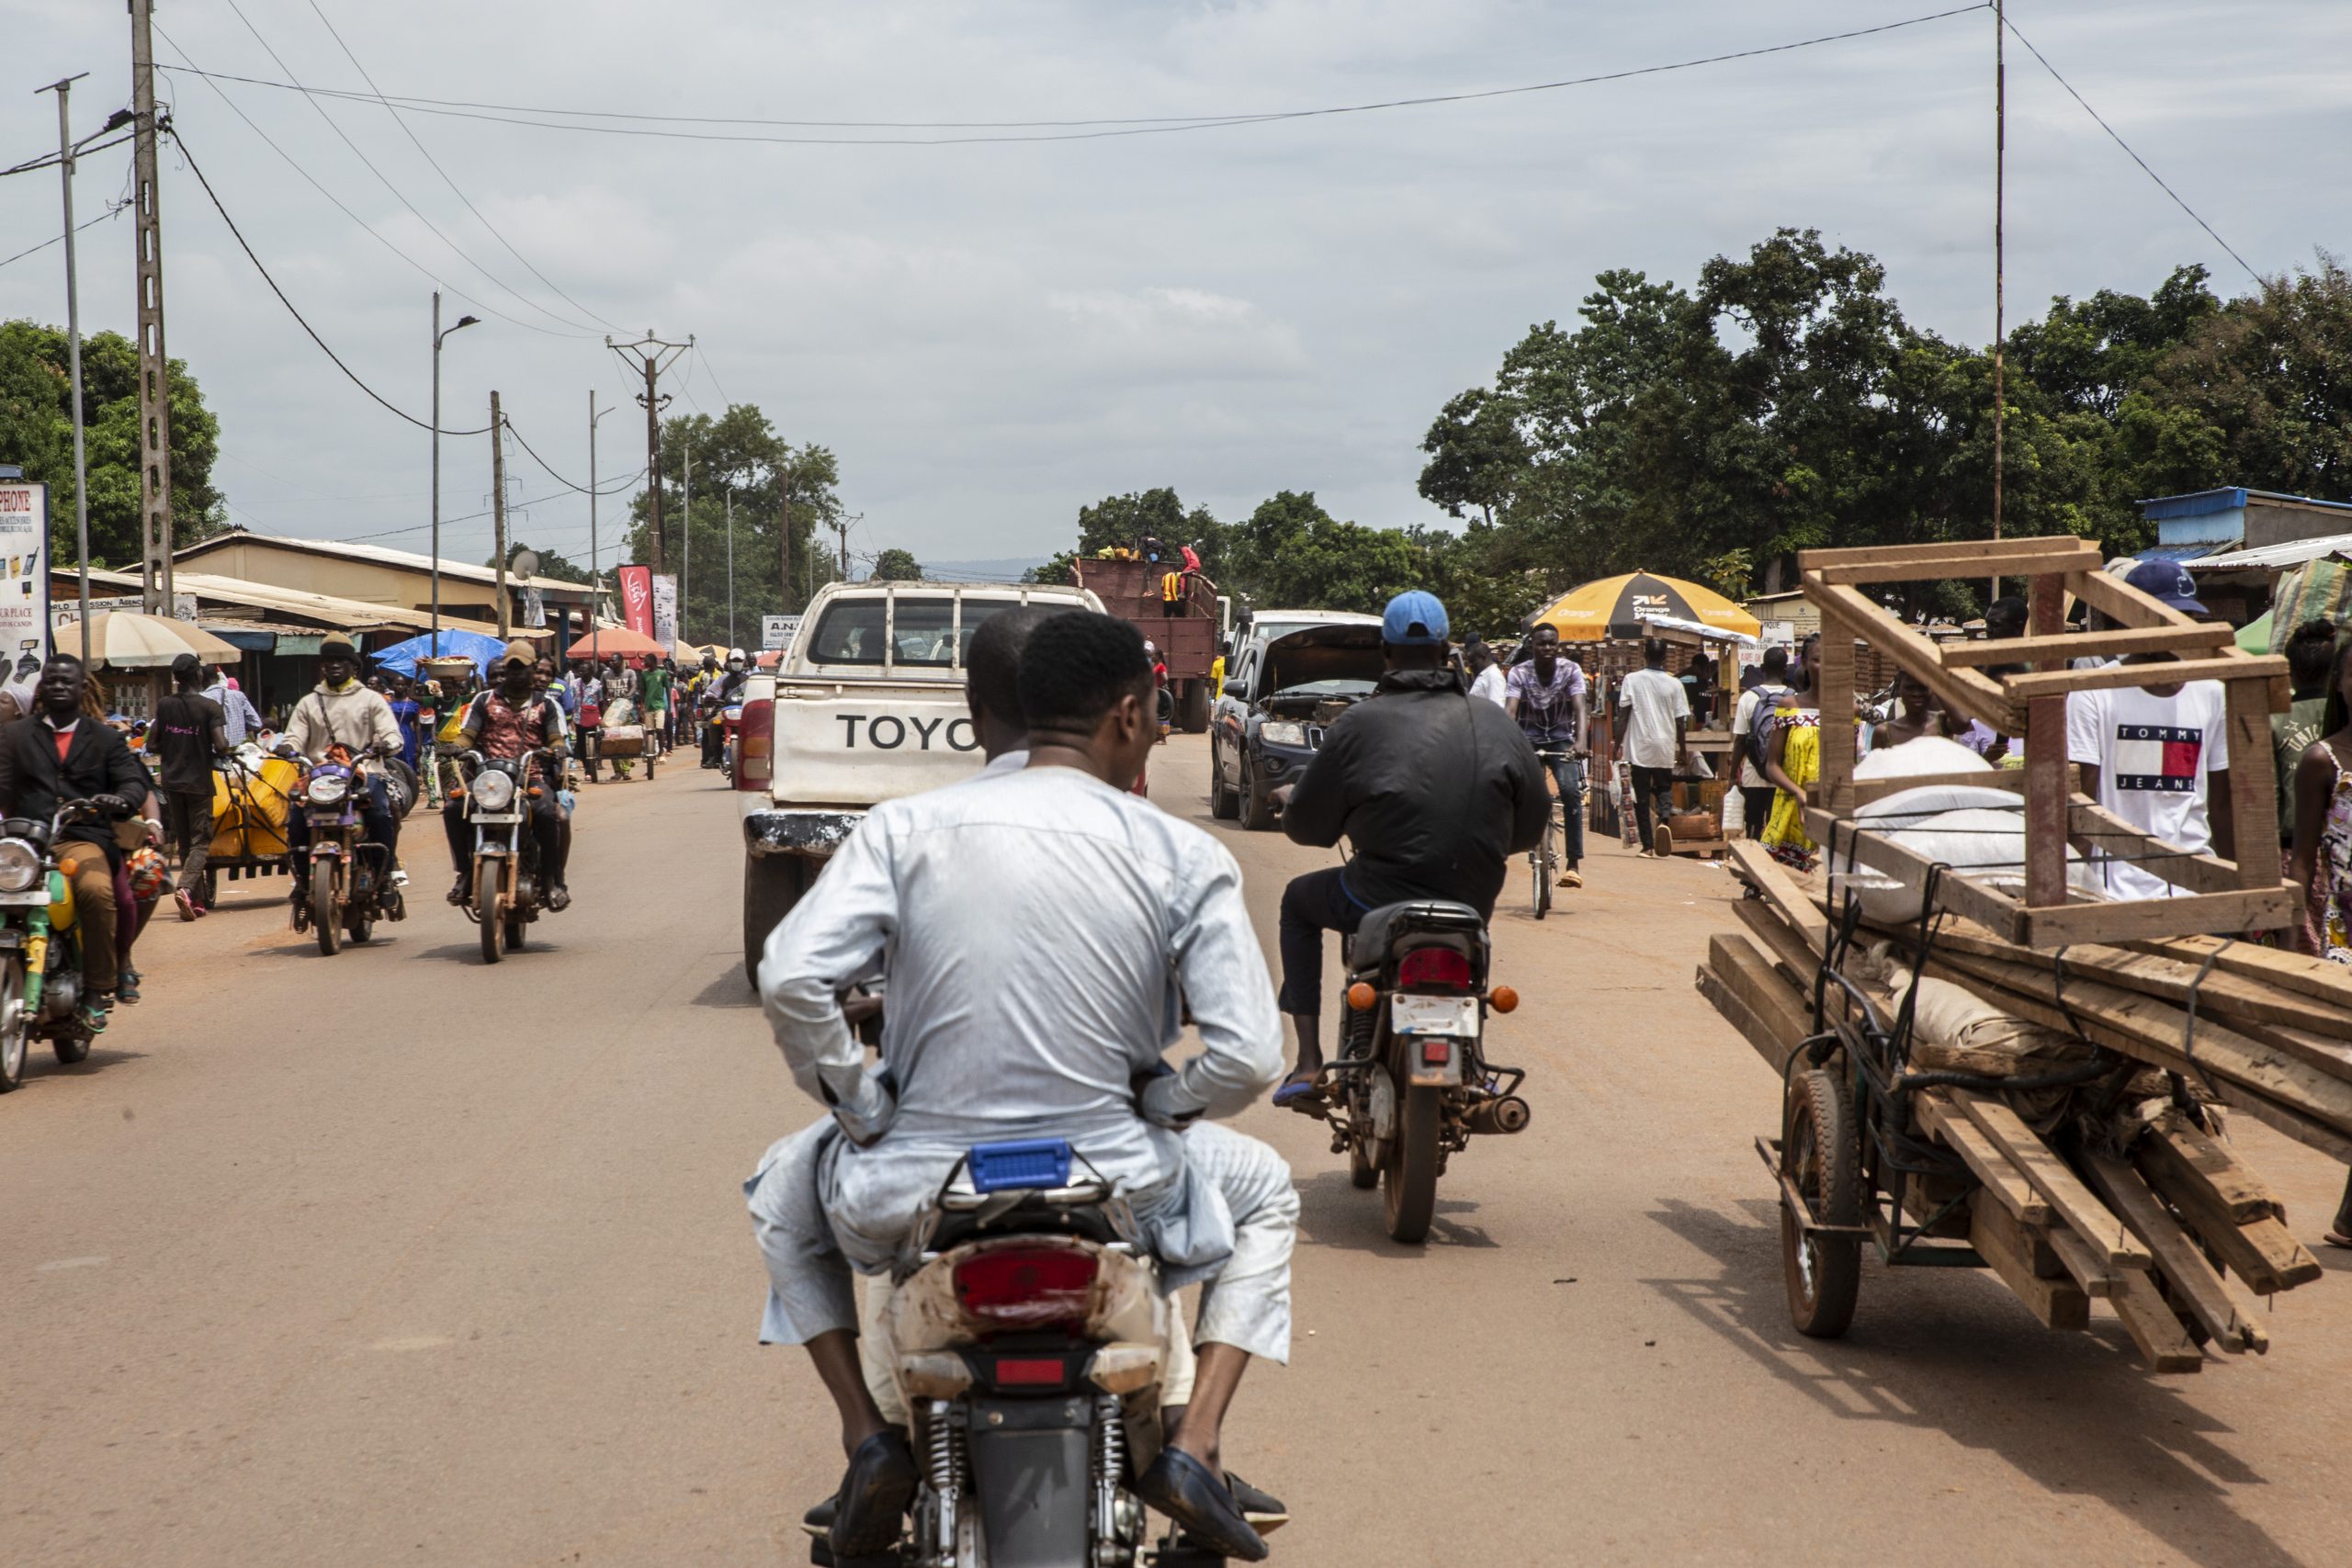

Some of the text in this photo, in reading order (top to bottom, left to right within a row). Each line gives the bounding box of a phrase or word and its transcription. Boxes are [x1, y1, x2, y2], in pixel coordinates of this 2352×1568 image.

[79, 599, 113, 609] SSION
[1557, 609, 1596, 618] Orange
[1634, 606, 1670, 615] Orange
[771, 622, 799, 631] A.N.
[836, 714, 980, 752] TOYO
[2121, 728, 2200, 740] TOMMY
[2120, 777, 2194, 790] JEANS
